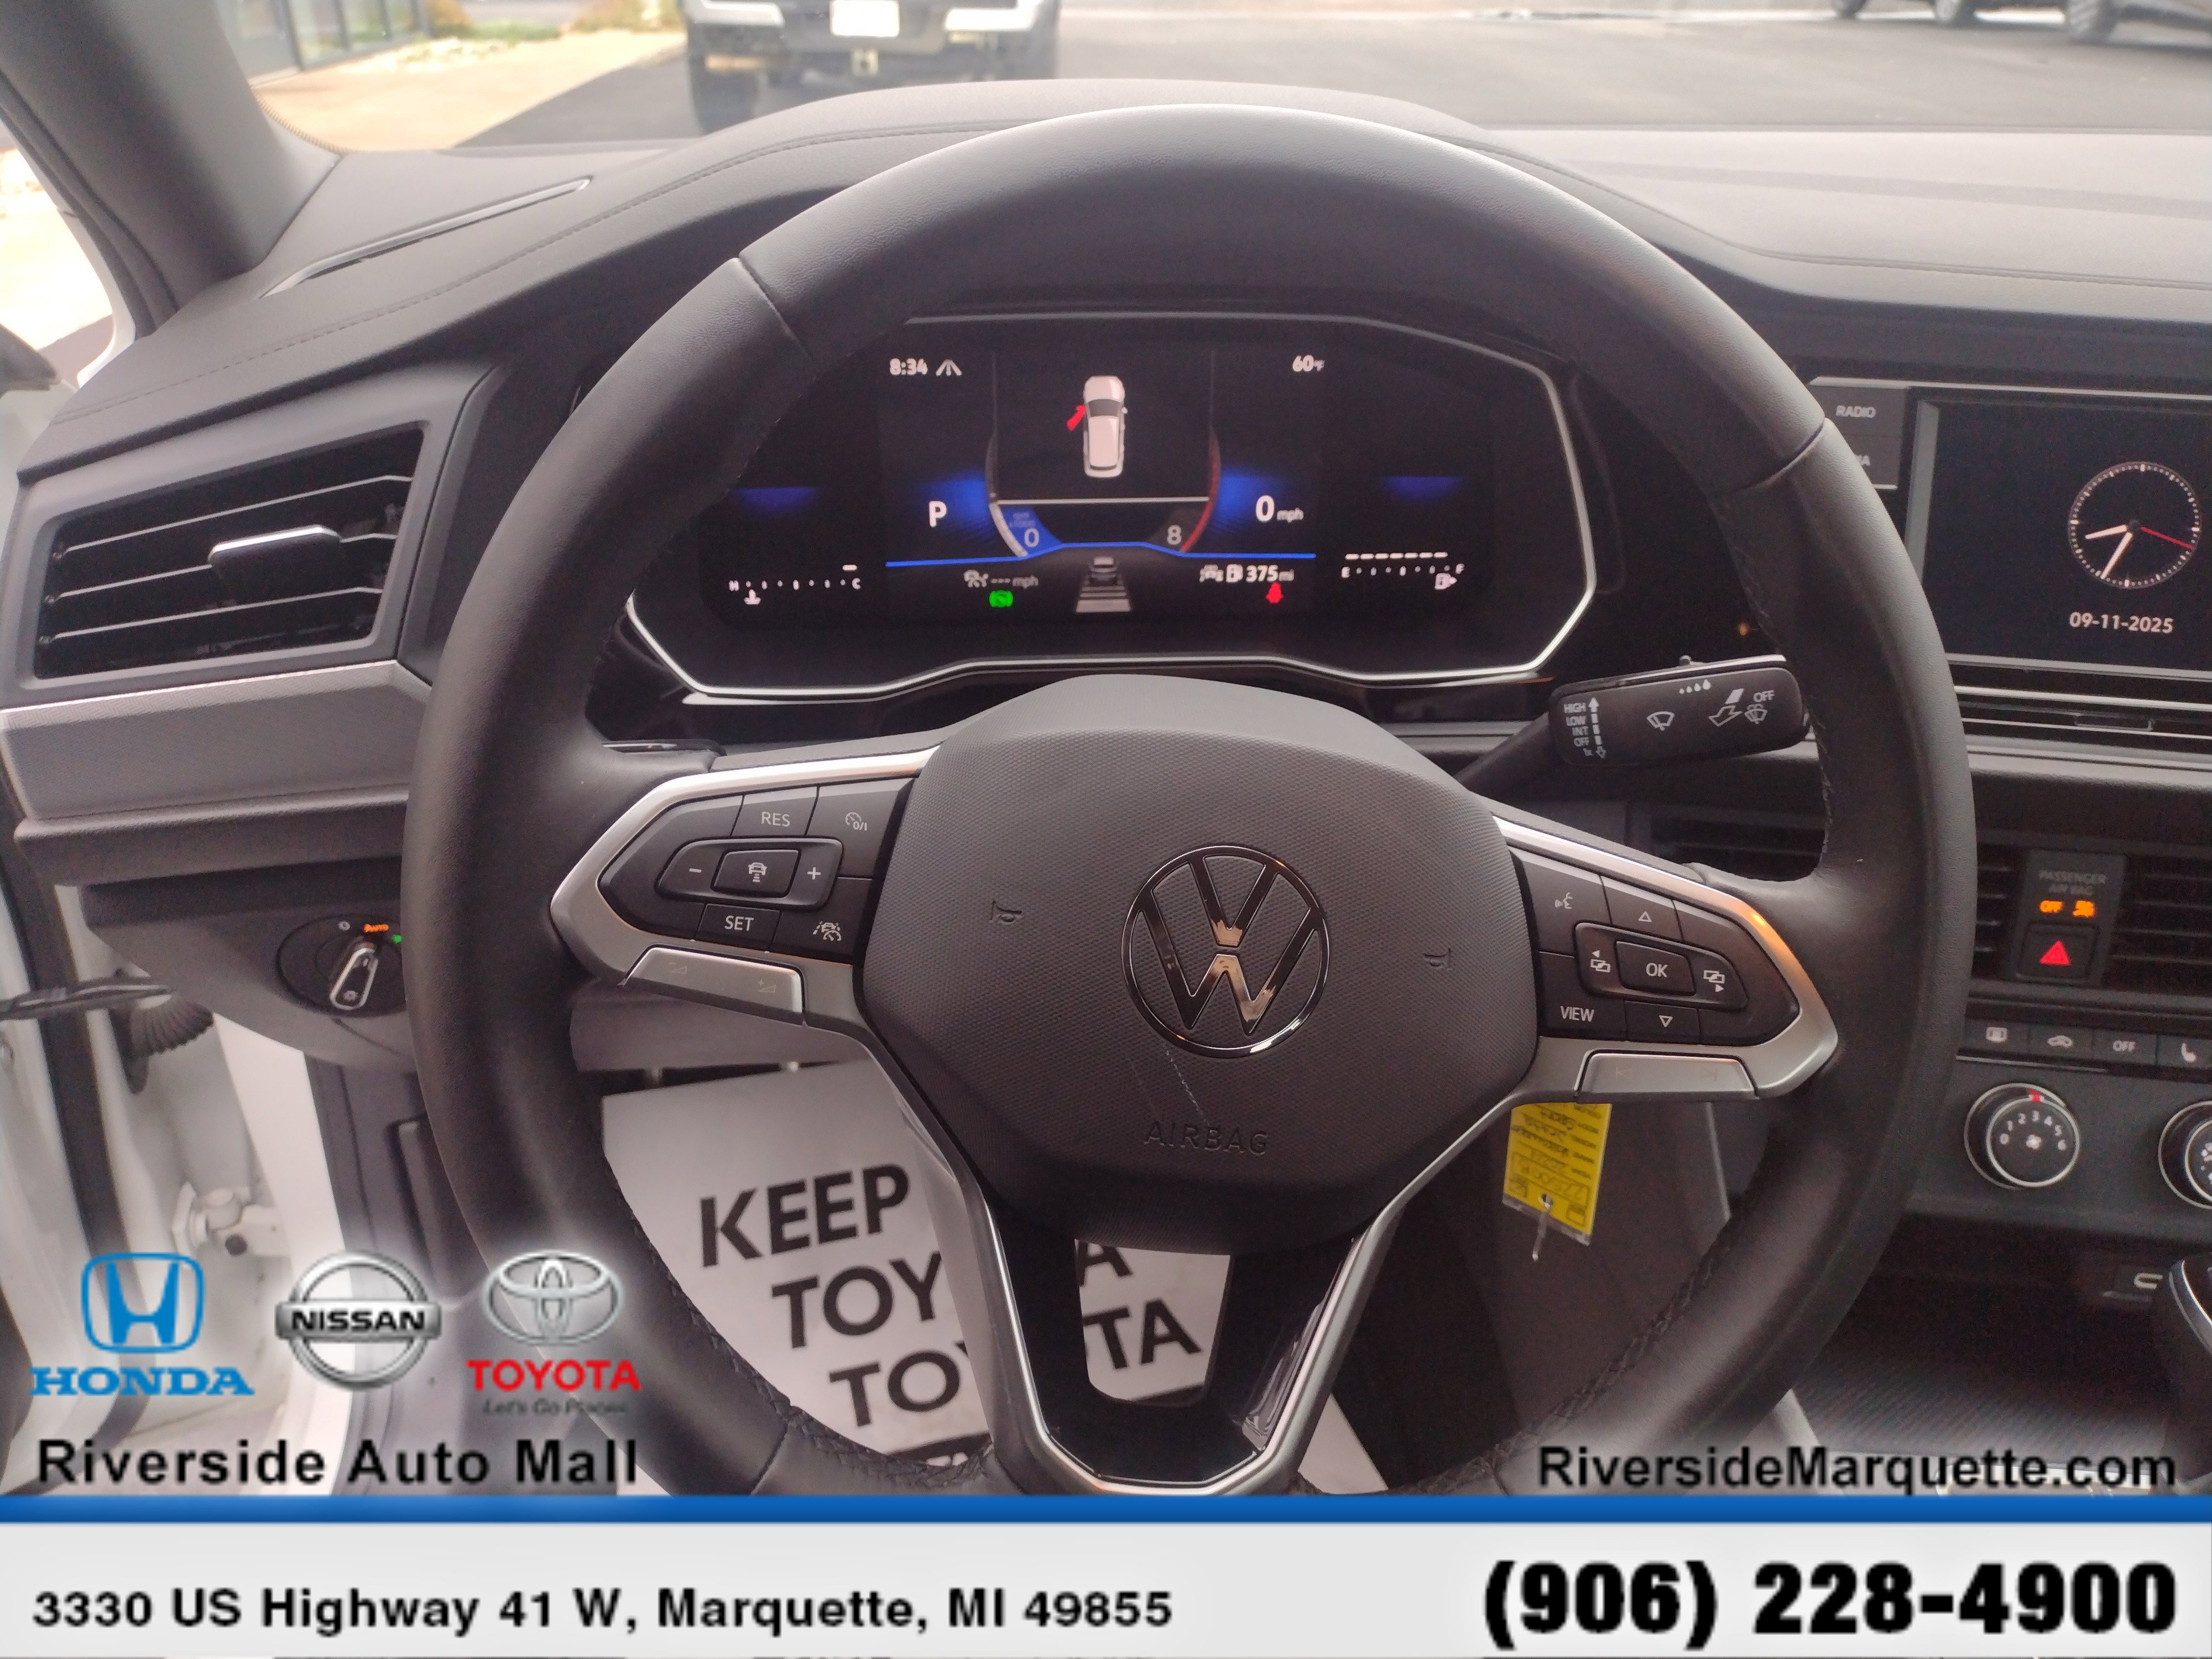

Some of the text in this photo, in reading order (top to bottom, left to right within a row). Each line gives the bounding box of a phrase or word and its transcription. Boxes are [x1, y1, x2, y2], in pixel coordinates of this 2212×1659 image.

[889, 358, 928, 375] 8:34
[1836, 405, 1876, 418] RADIO
[928, 500, 947, 527] P
[1255, 495, 1275, 523] 0
[1024, 528, 1040, 547] 0
[1167, 525, 1182, 545] 8
[1246, 565, 1279, 583] 375
[2069, 611, 2174, 634] 09-11-2025
[1753, 690, 1775, 702] OFF
[1564, 703, 1587, 713] HIGH
[1566, 716, 1587, 726] LOW
[1572, 726, 1589, 736] INT
[1574, 737, 1590, 747] OFF
[761, 811, 791, 827] RES
[724, 916, 754, 932] SET
[1646, 963, 1668, 978] OK
[1561, 1005, 1595, 1022] VIEW
[2112, 1040, 2136, 1052] OFF
[1143, 1120, 1269, 1156] AIRBAG
[700, 1164, 909, 1267] KEEP
